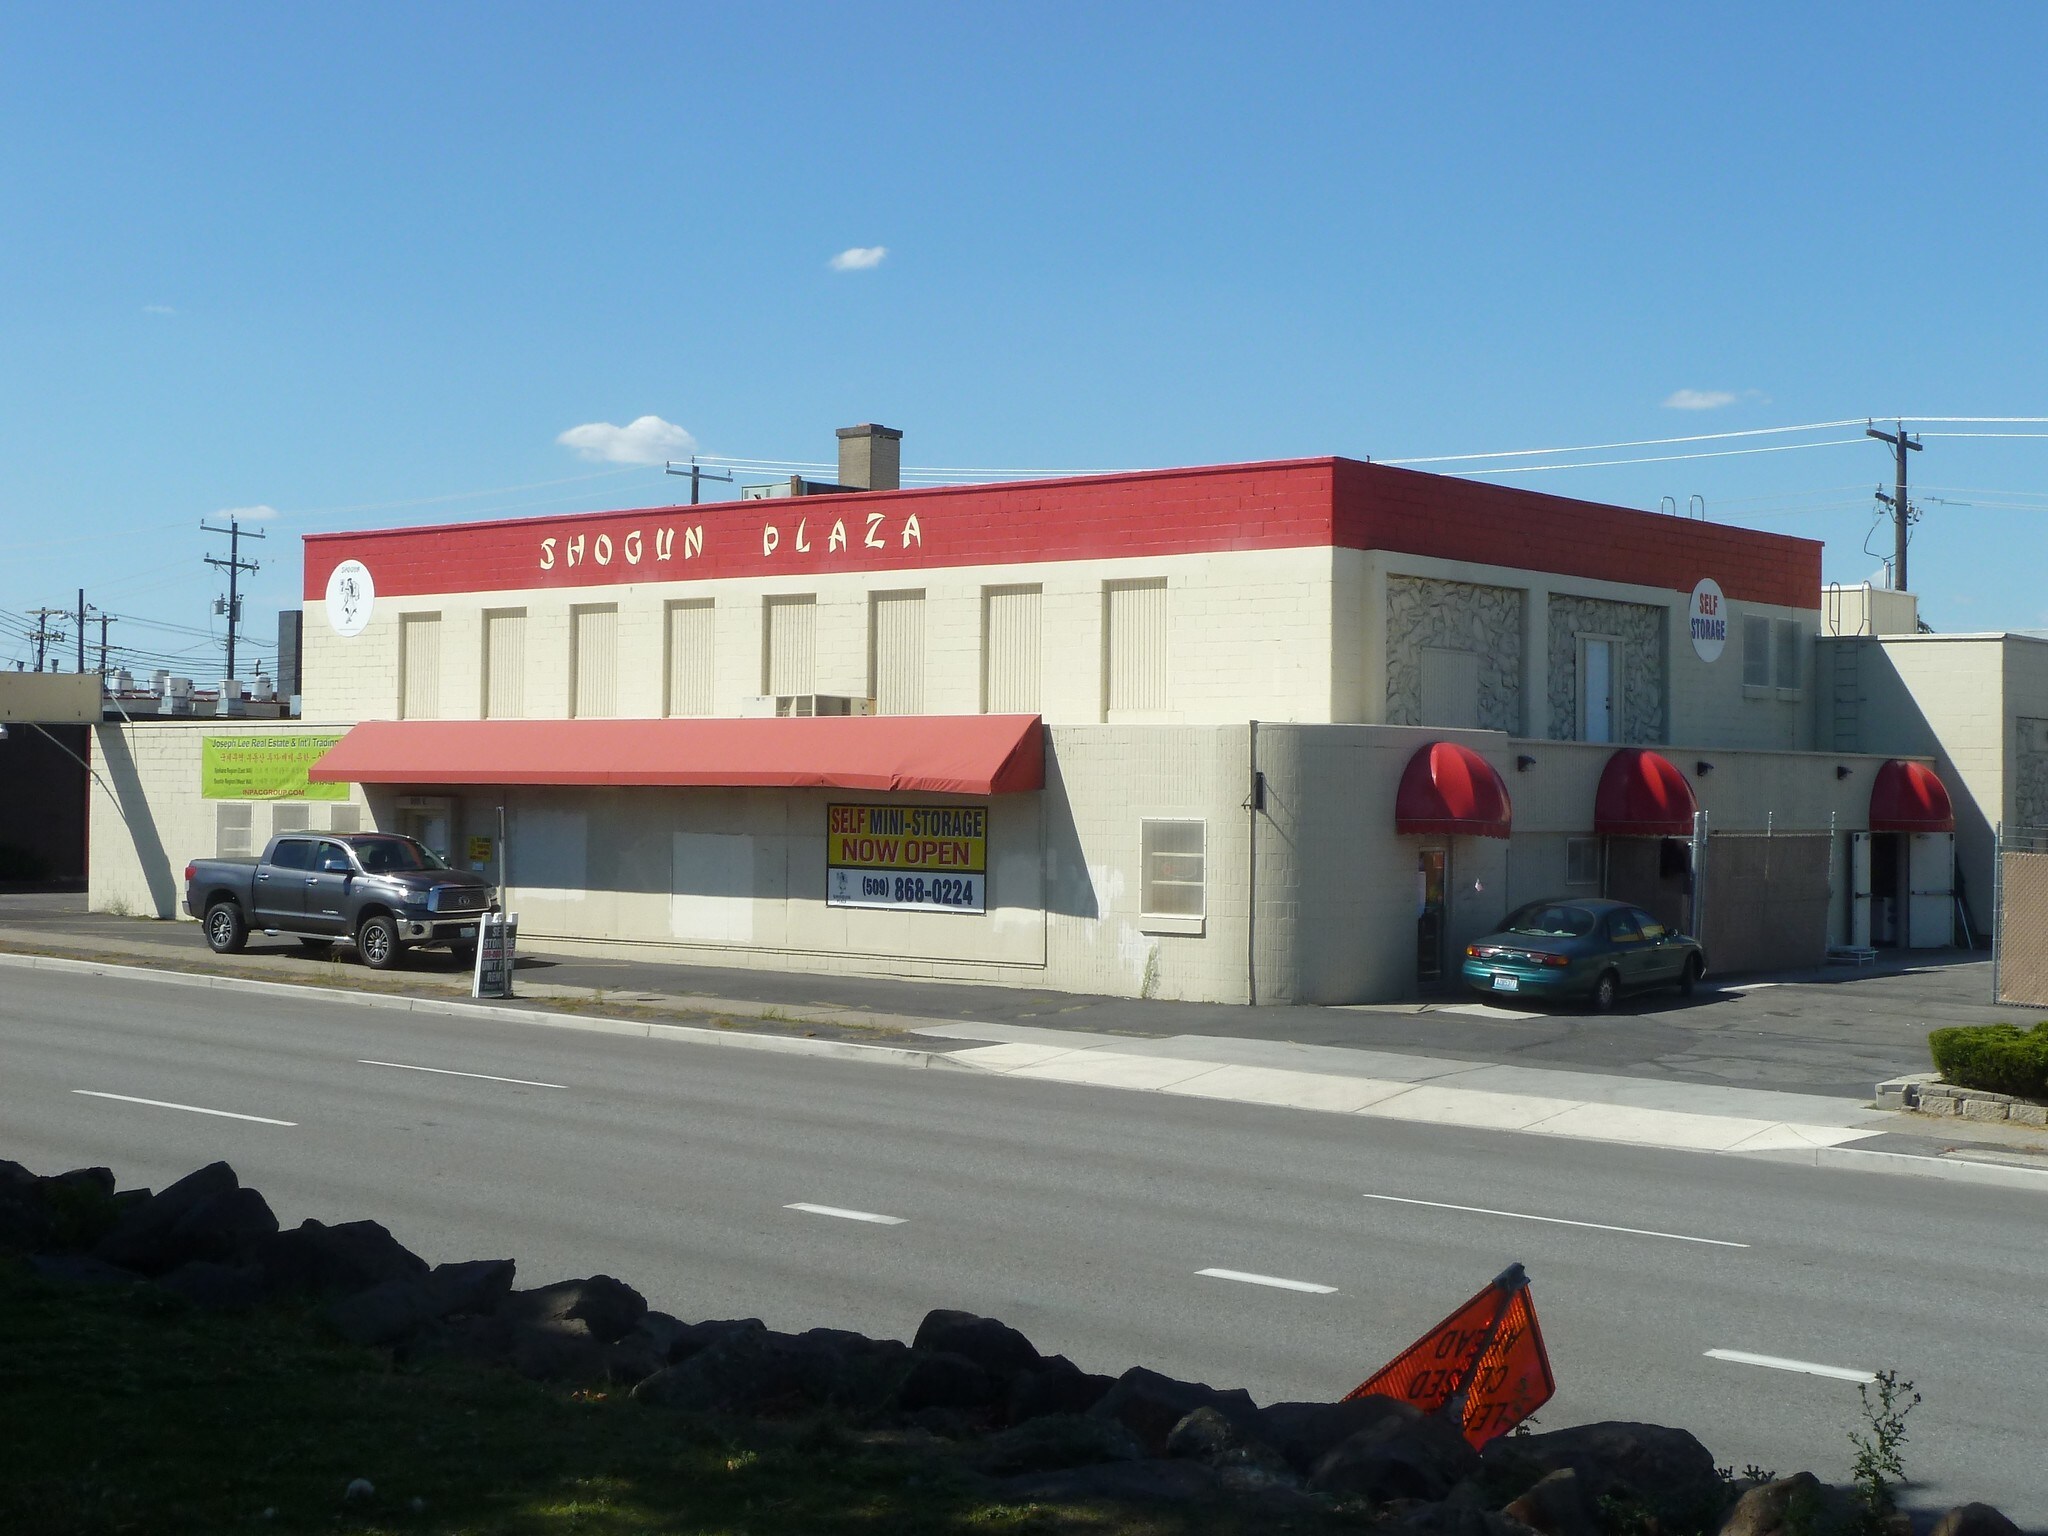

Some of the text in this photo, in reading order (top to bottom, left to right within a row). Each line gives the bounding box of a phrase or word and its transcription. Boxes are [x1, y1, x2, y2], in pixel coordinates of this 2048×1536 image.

[539, 512, 923, 571] SHOGUN PLAZA
[1699, 592, 1718, 616] SELF
[1691, 617, 1725, 641] STORAGE
[212, 738, 236, 748] Joseph
[237, 738, 250, 747] Lee
[251, 738, 267, 747] Real
[267, 738, 290, 747] Estate
[291, 738, 296, 747] &
[242, 789, 305, 797] INPACGROUP.COM
[831, 807, 982, 838] SELF MINI-STORAGE
[841, 838, 970, 866] NOW OPEN
[862, 875, 973, 905] (509) 868-0224
[484, 938, 514, 949] STORGE
[492, 926, 509, 937] SEF
[499, 960, 513, 970] FR
[1408, 1365, 1509, 1399] CLSED
